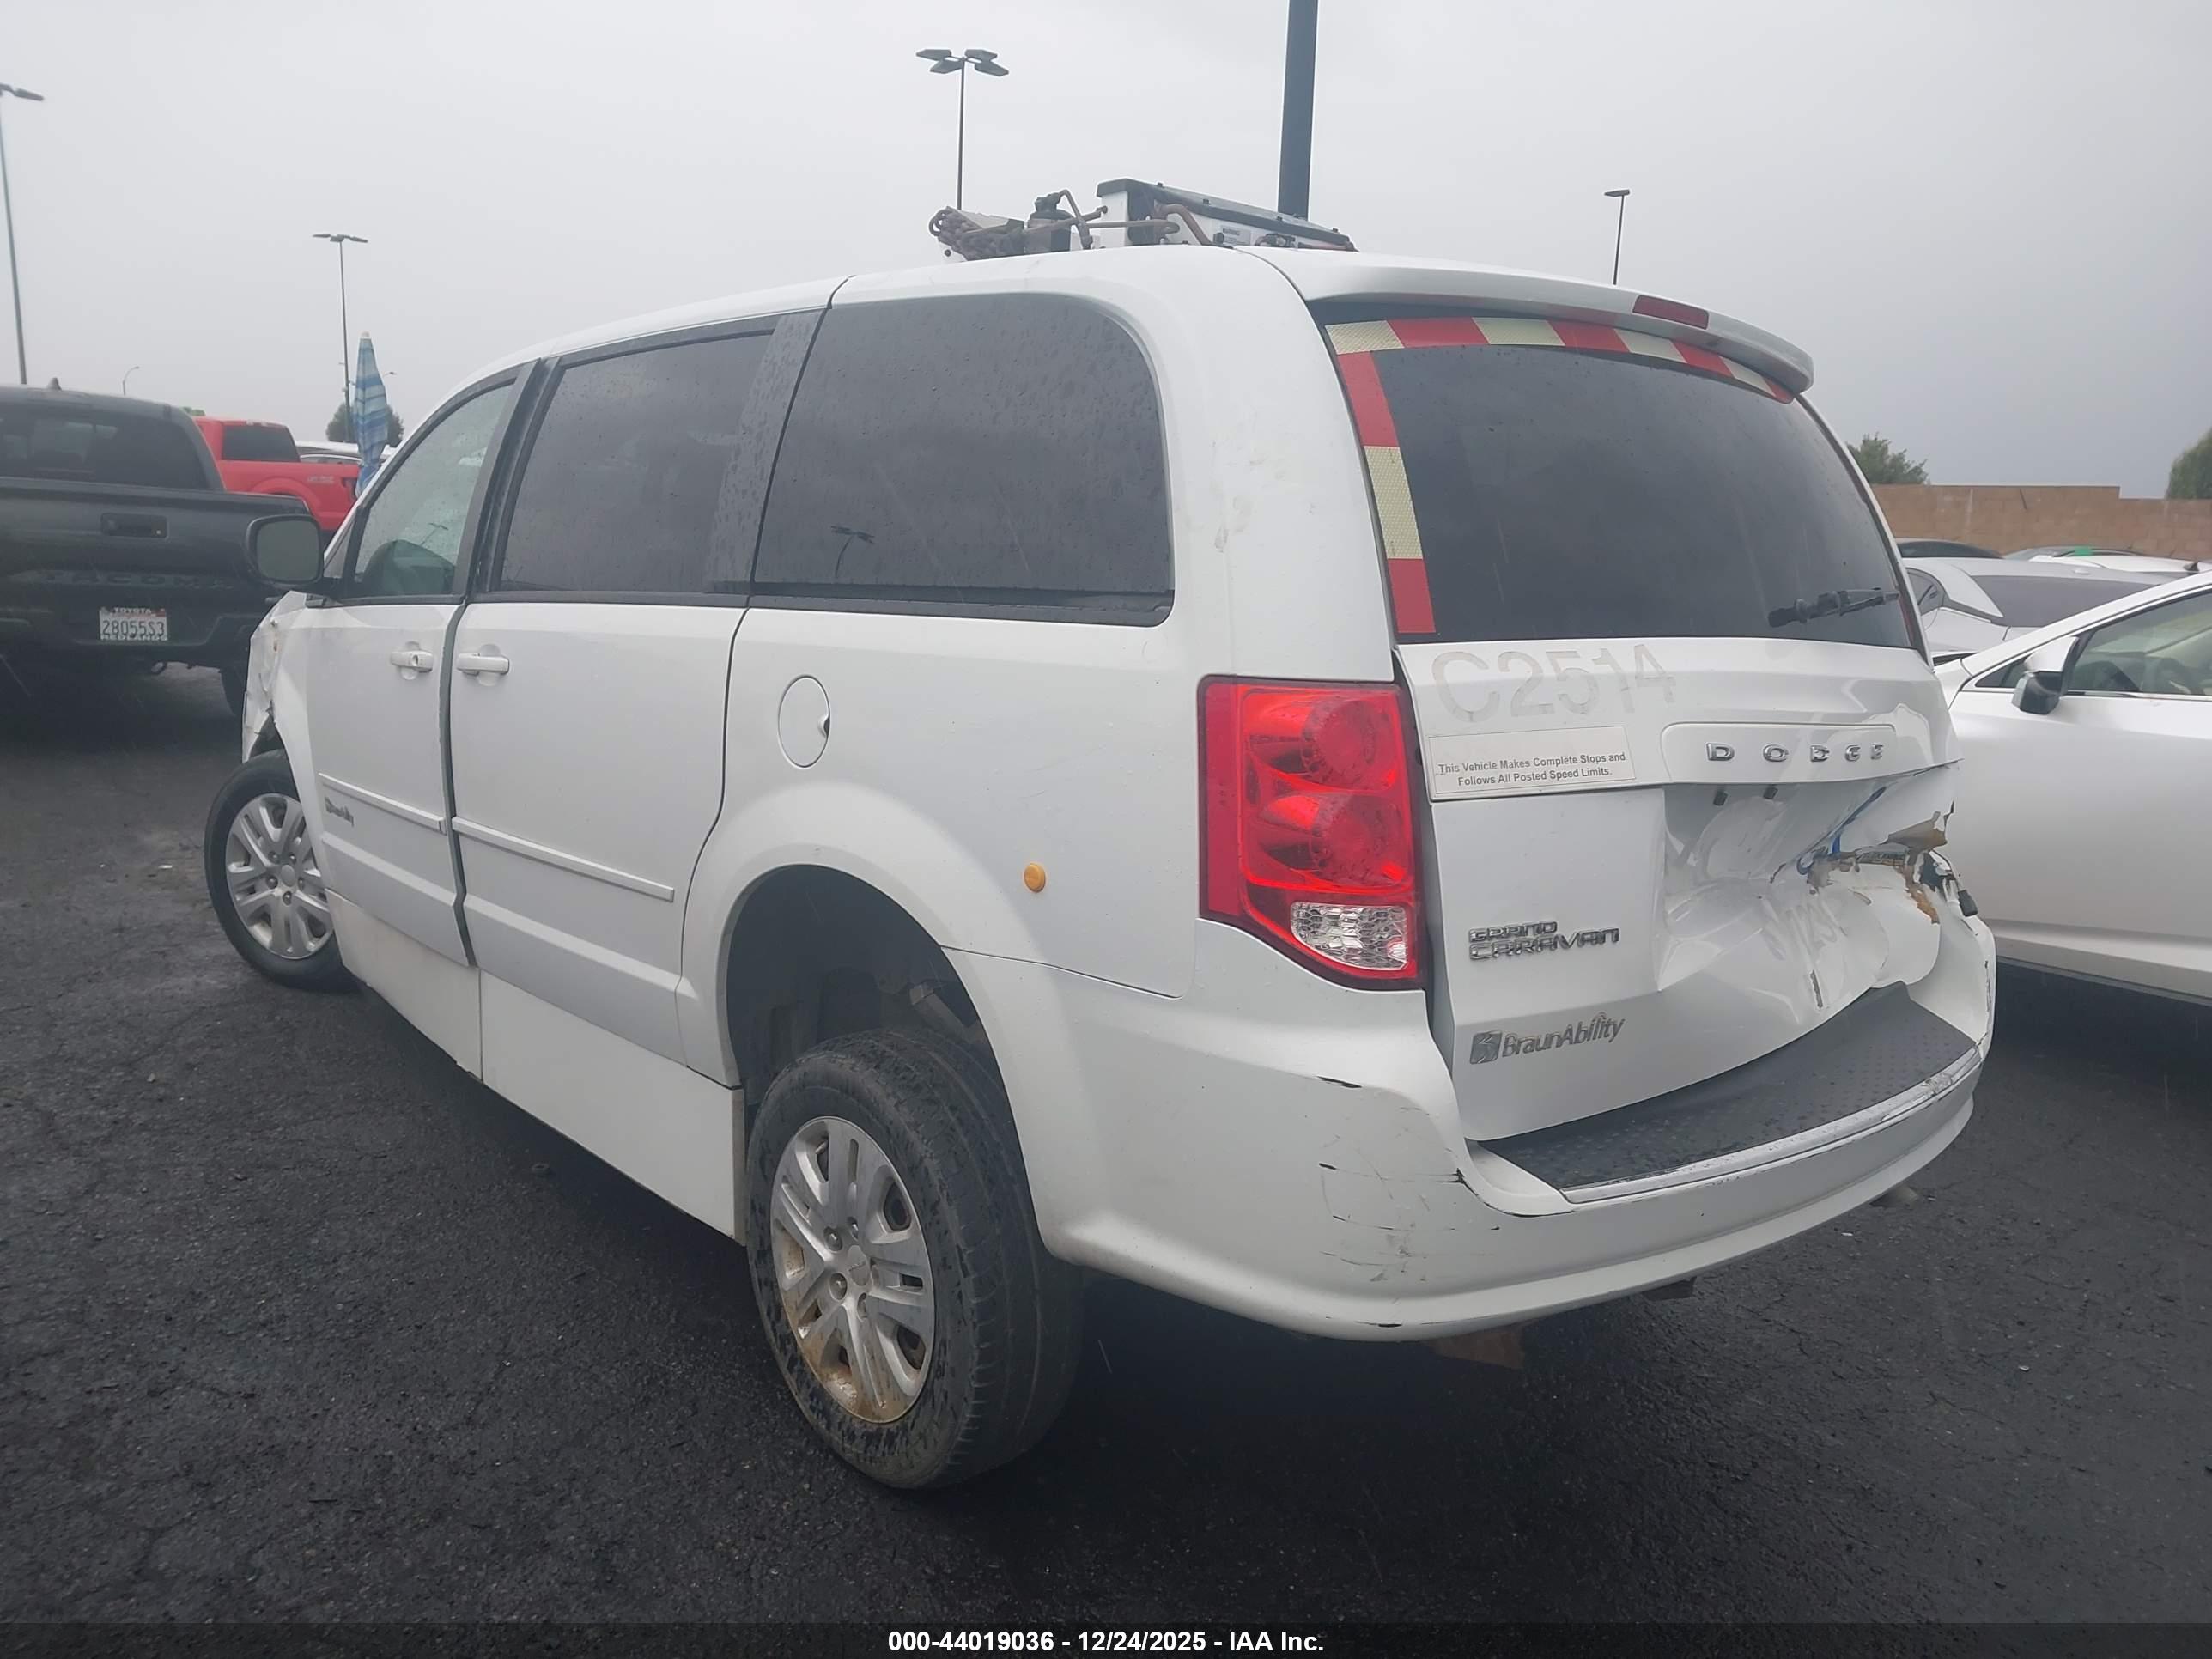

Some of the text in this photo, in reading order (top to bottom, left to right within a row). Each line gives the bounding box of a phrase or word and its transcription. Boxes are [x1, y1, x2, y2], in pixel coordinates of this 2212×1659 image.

[1431, 644, 1674, 723] C2514
[1438, 752, 1626, 775] This Vehicle Makes Complete Stops and
[1458, 766, 1613, 786] Follows All Posted Speed Limits.
[1468, 921, 1558, 942] GRAND
[1469, 928, 1620, 960] CARAVAN
[1502, 1013, 1625, 1057] BraunAbility
